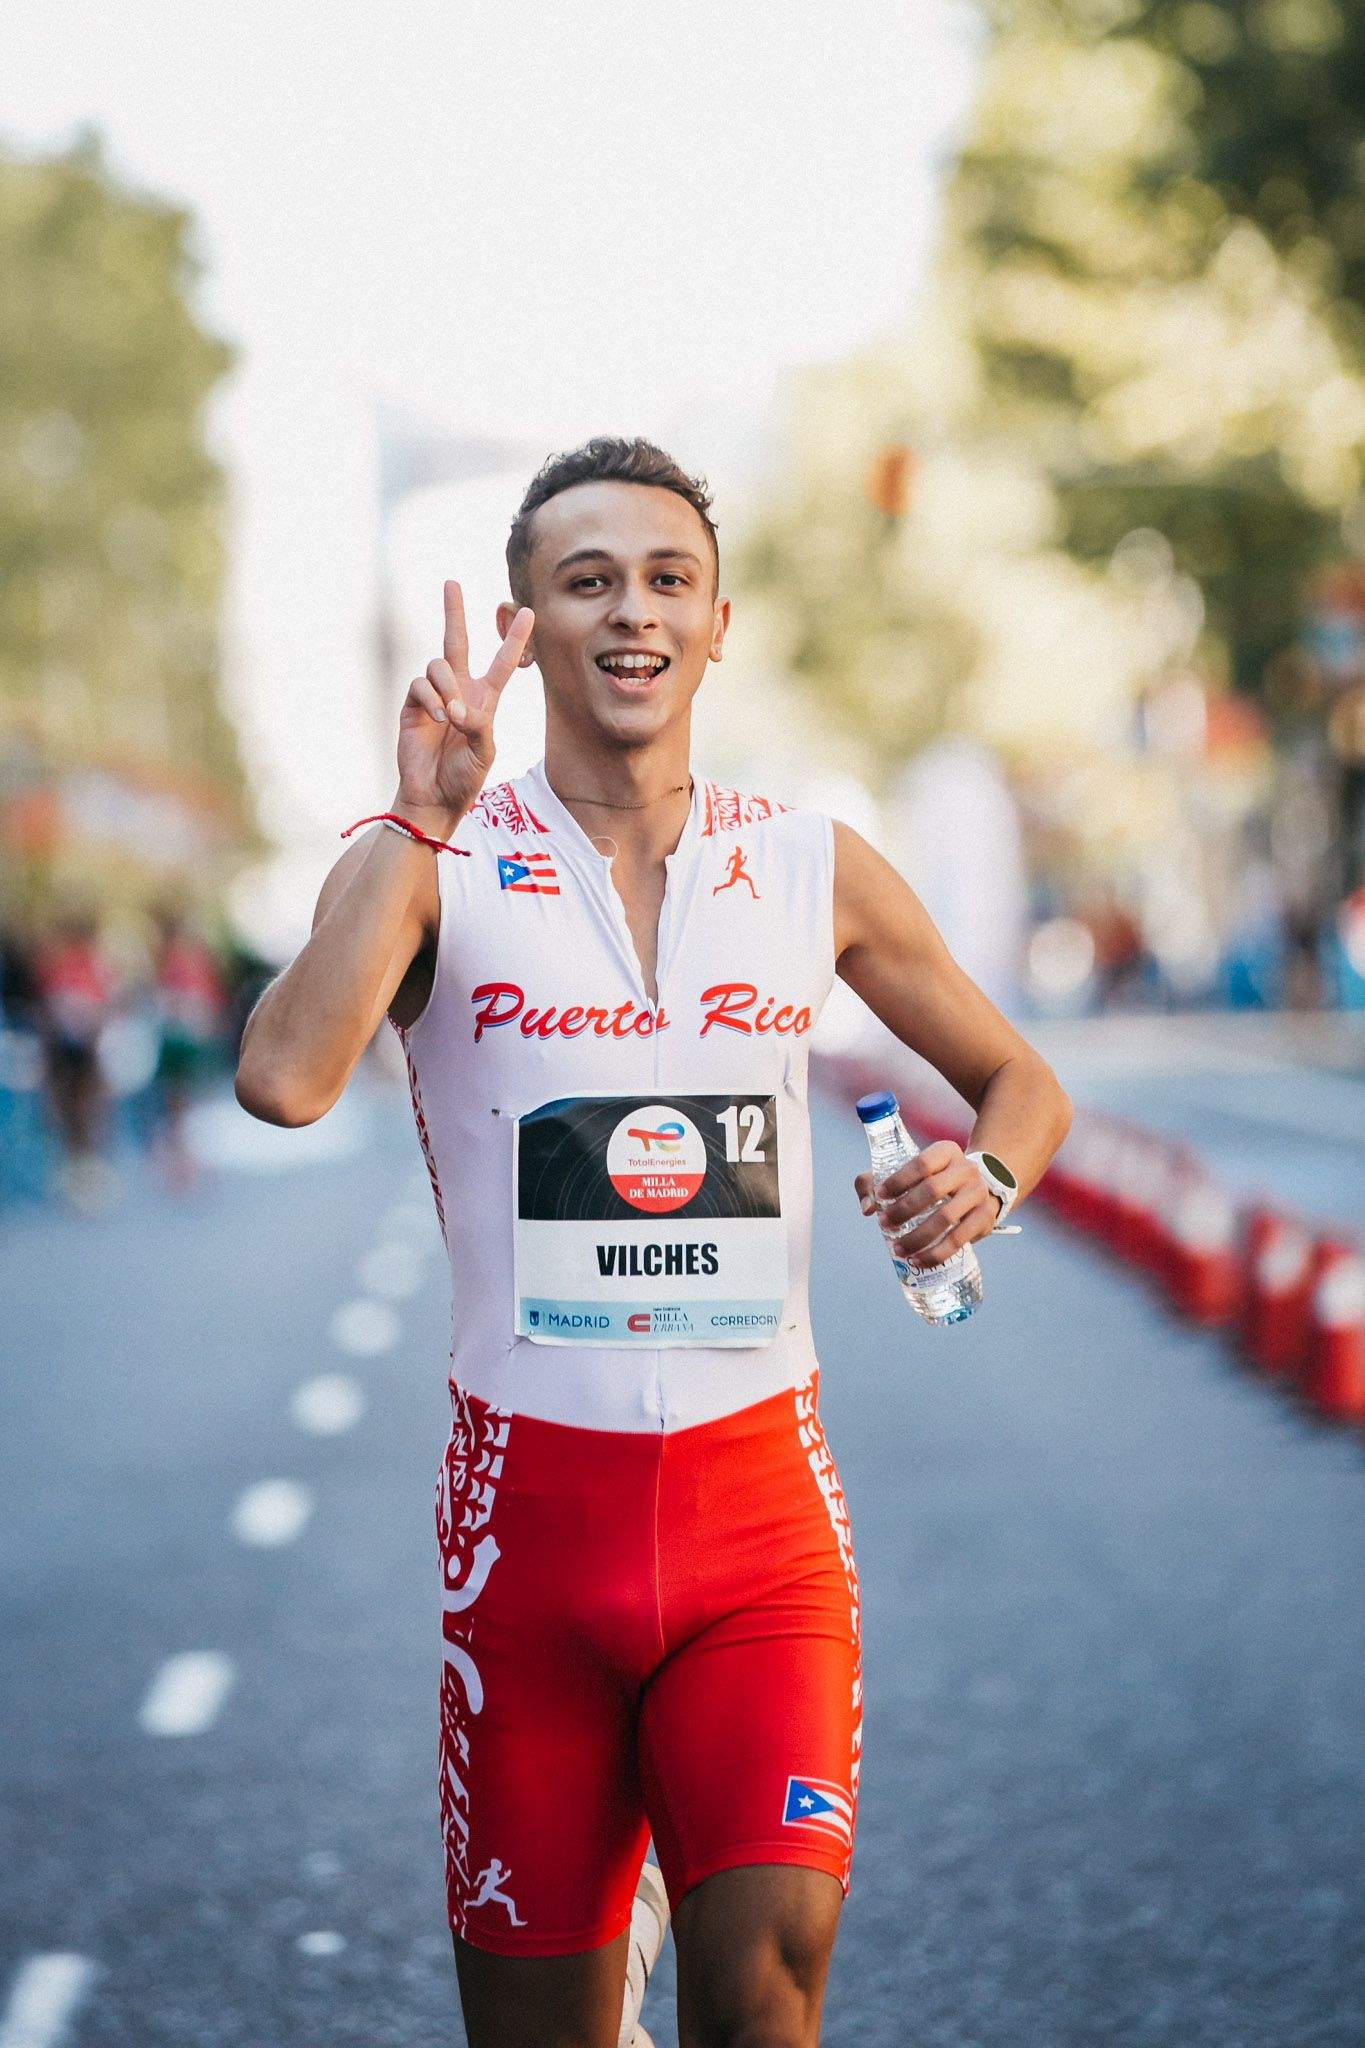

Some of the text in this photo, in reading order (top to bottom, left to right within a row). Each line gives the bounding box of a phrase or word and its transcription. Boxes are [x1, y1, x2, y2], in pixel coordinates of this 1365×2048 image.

[471, 982, 813, 1044] Puerto Rico
[716, 1104, 765, 1163] 12
[628, 1158, 687, 1168] TotalEnergies
[642, 1177, 676, 1187] MILLA
[629, 1188, 689, 1198] DE MADRID
[596, 1243, 719, 1276] VILCHES
[548, 1313, 610, 1329] MADRID
[655, 1313, 688, 1322] MILLA
